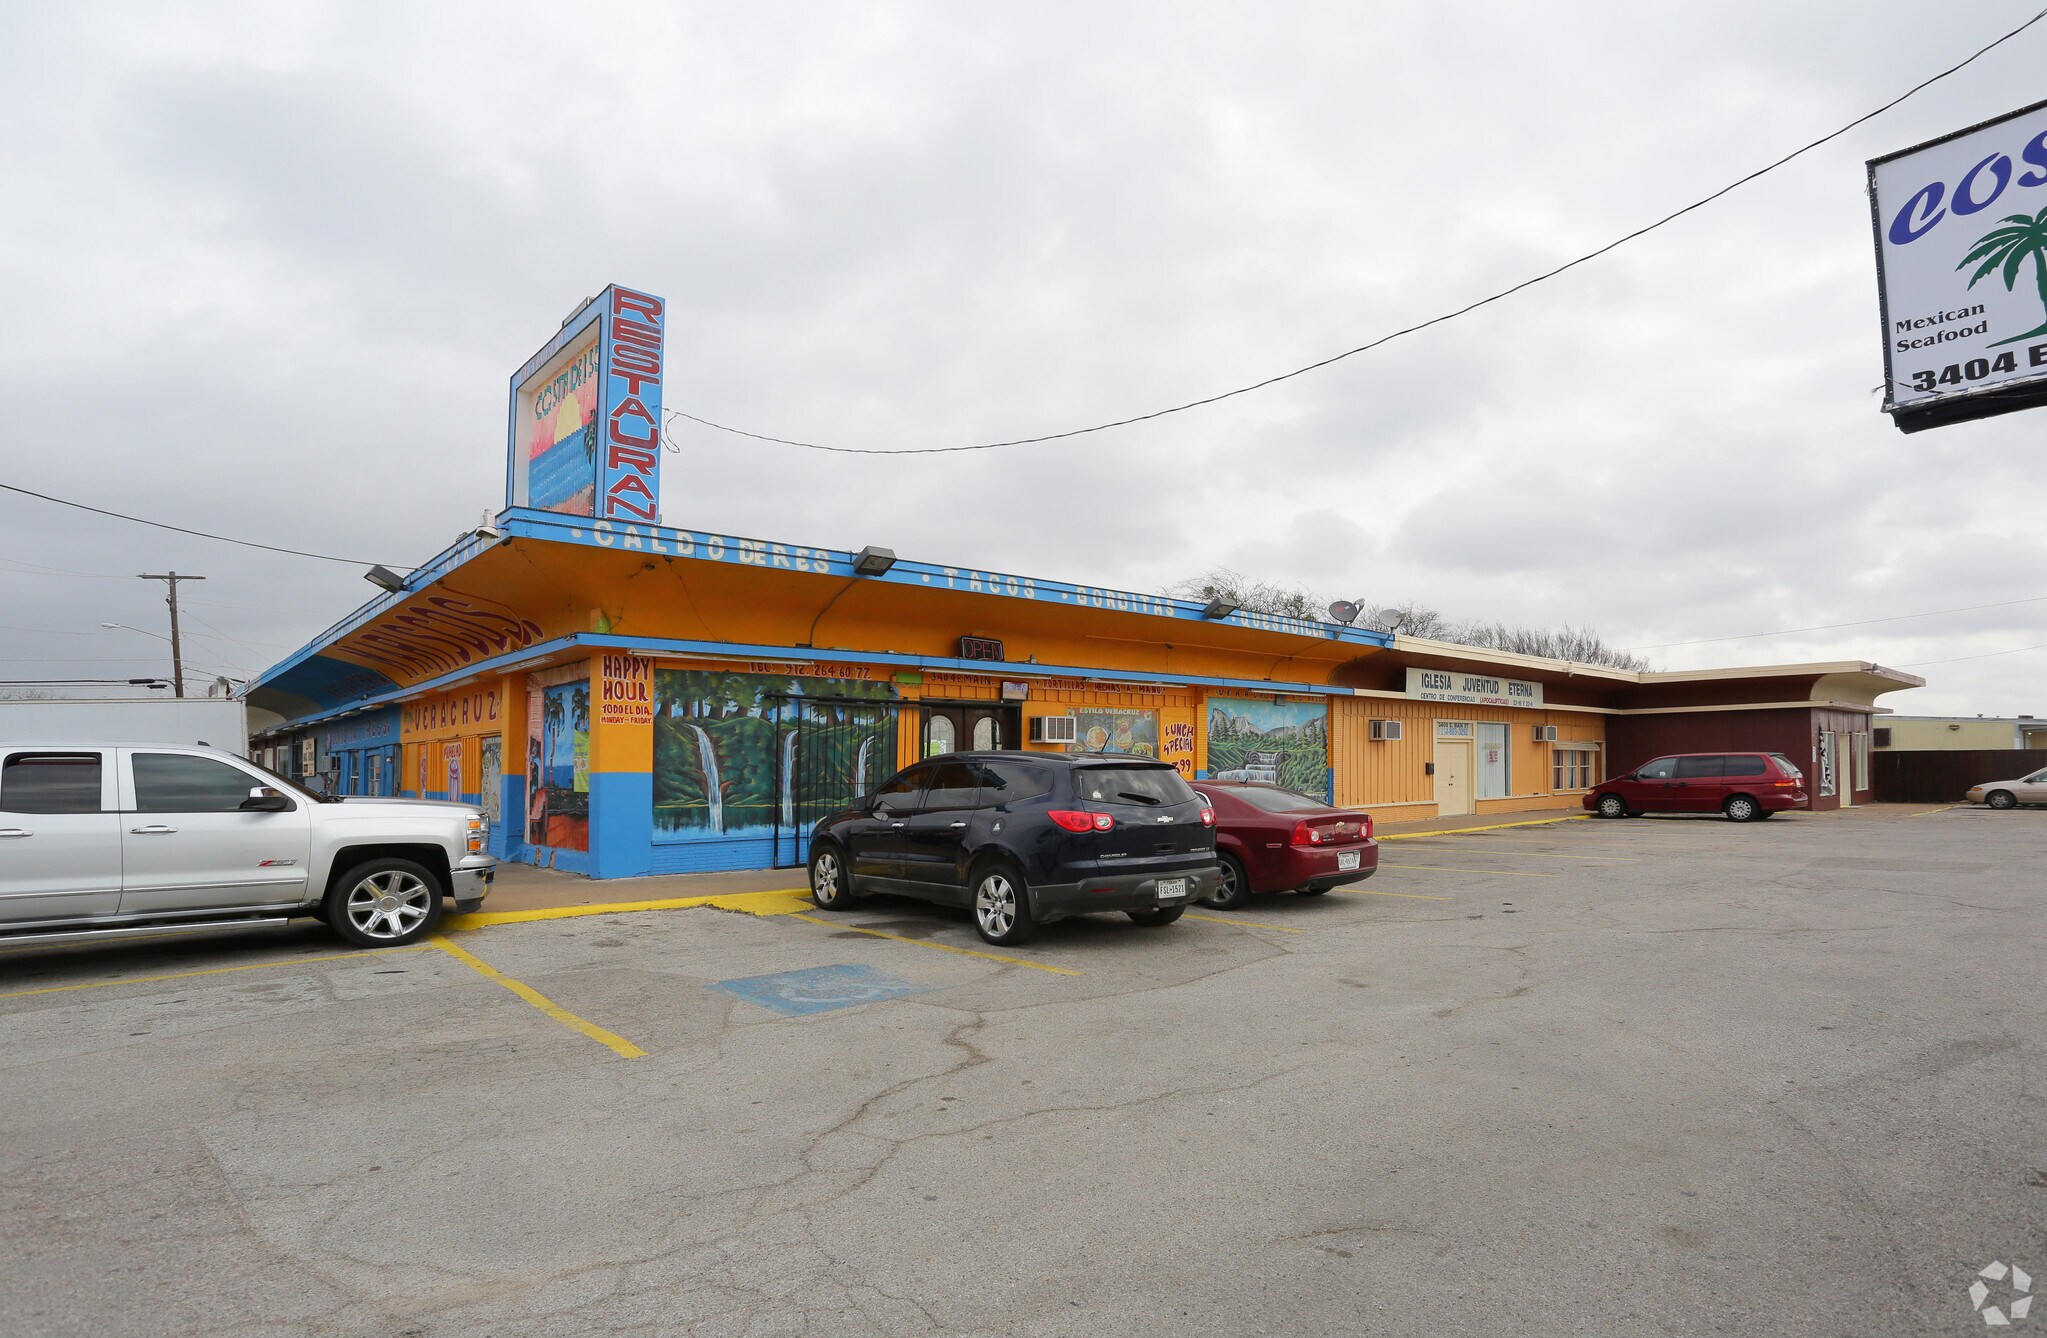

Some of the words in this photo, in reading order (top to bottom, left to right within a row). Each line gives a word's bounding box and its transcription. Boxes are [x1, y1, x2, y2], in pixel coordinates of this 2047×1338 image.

[1895, 303, 1986, 334] Mexican
[1896, 320, 1989, 353] Seafood
[1911, 350, 2018, 392] 3404
[606, 287, 662, 525] RESTAURAN
[593, 520, 726, 561] CALDO
[771, 545, 831, 574] RES
[943, 567, 1036, 600] TACOS
[1076, 585, 1175, 618] GORDITAS
[962, 639, 1004, 661] OPEN
[603, 655, 651, 681] HAPPY
[814, 665, 835, 678] 264
[839, 667, 850, 678] 60
[603, 681, 649, 702] HOUR
[1043, 679, 1085, 691] TORTILLAS
[1421, 673, 1452, 690] IGLESIA
[1463, 678, 1499, 694] JUVENTUD
[1508, 682, 1533, 698] ETERNA
[1421, 692, 1437, 700] CENTRO
[415, 691, 497, 731] VERACRUZ
[601, 703, 624, 715] TODO
[624, 704, 634, 715] EL
[1079, 707, 1104, 715] ESTILO
[1105, 708, 1140, 716] VERACRUZ
[1165, 723, 1194, 738] LUNCH
[1163, 737, 1194, 757] SPECIAL
